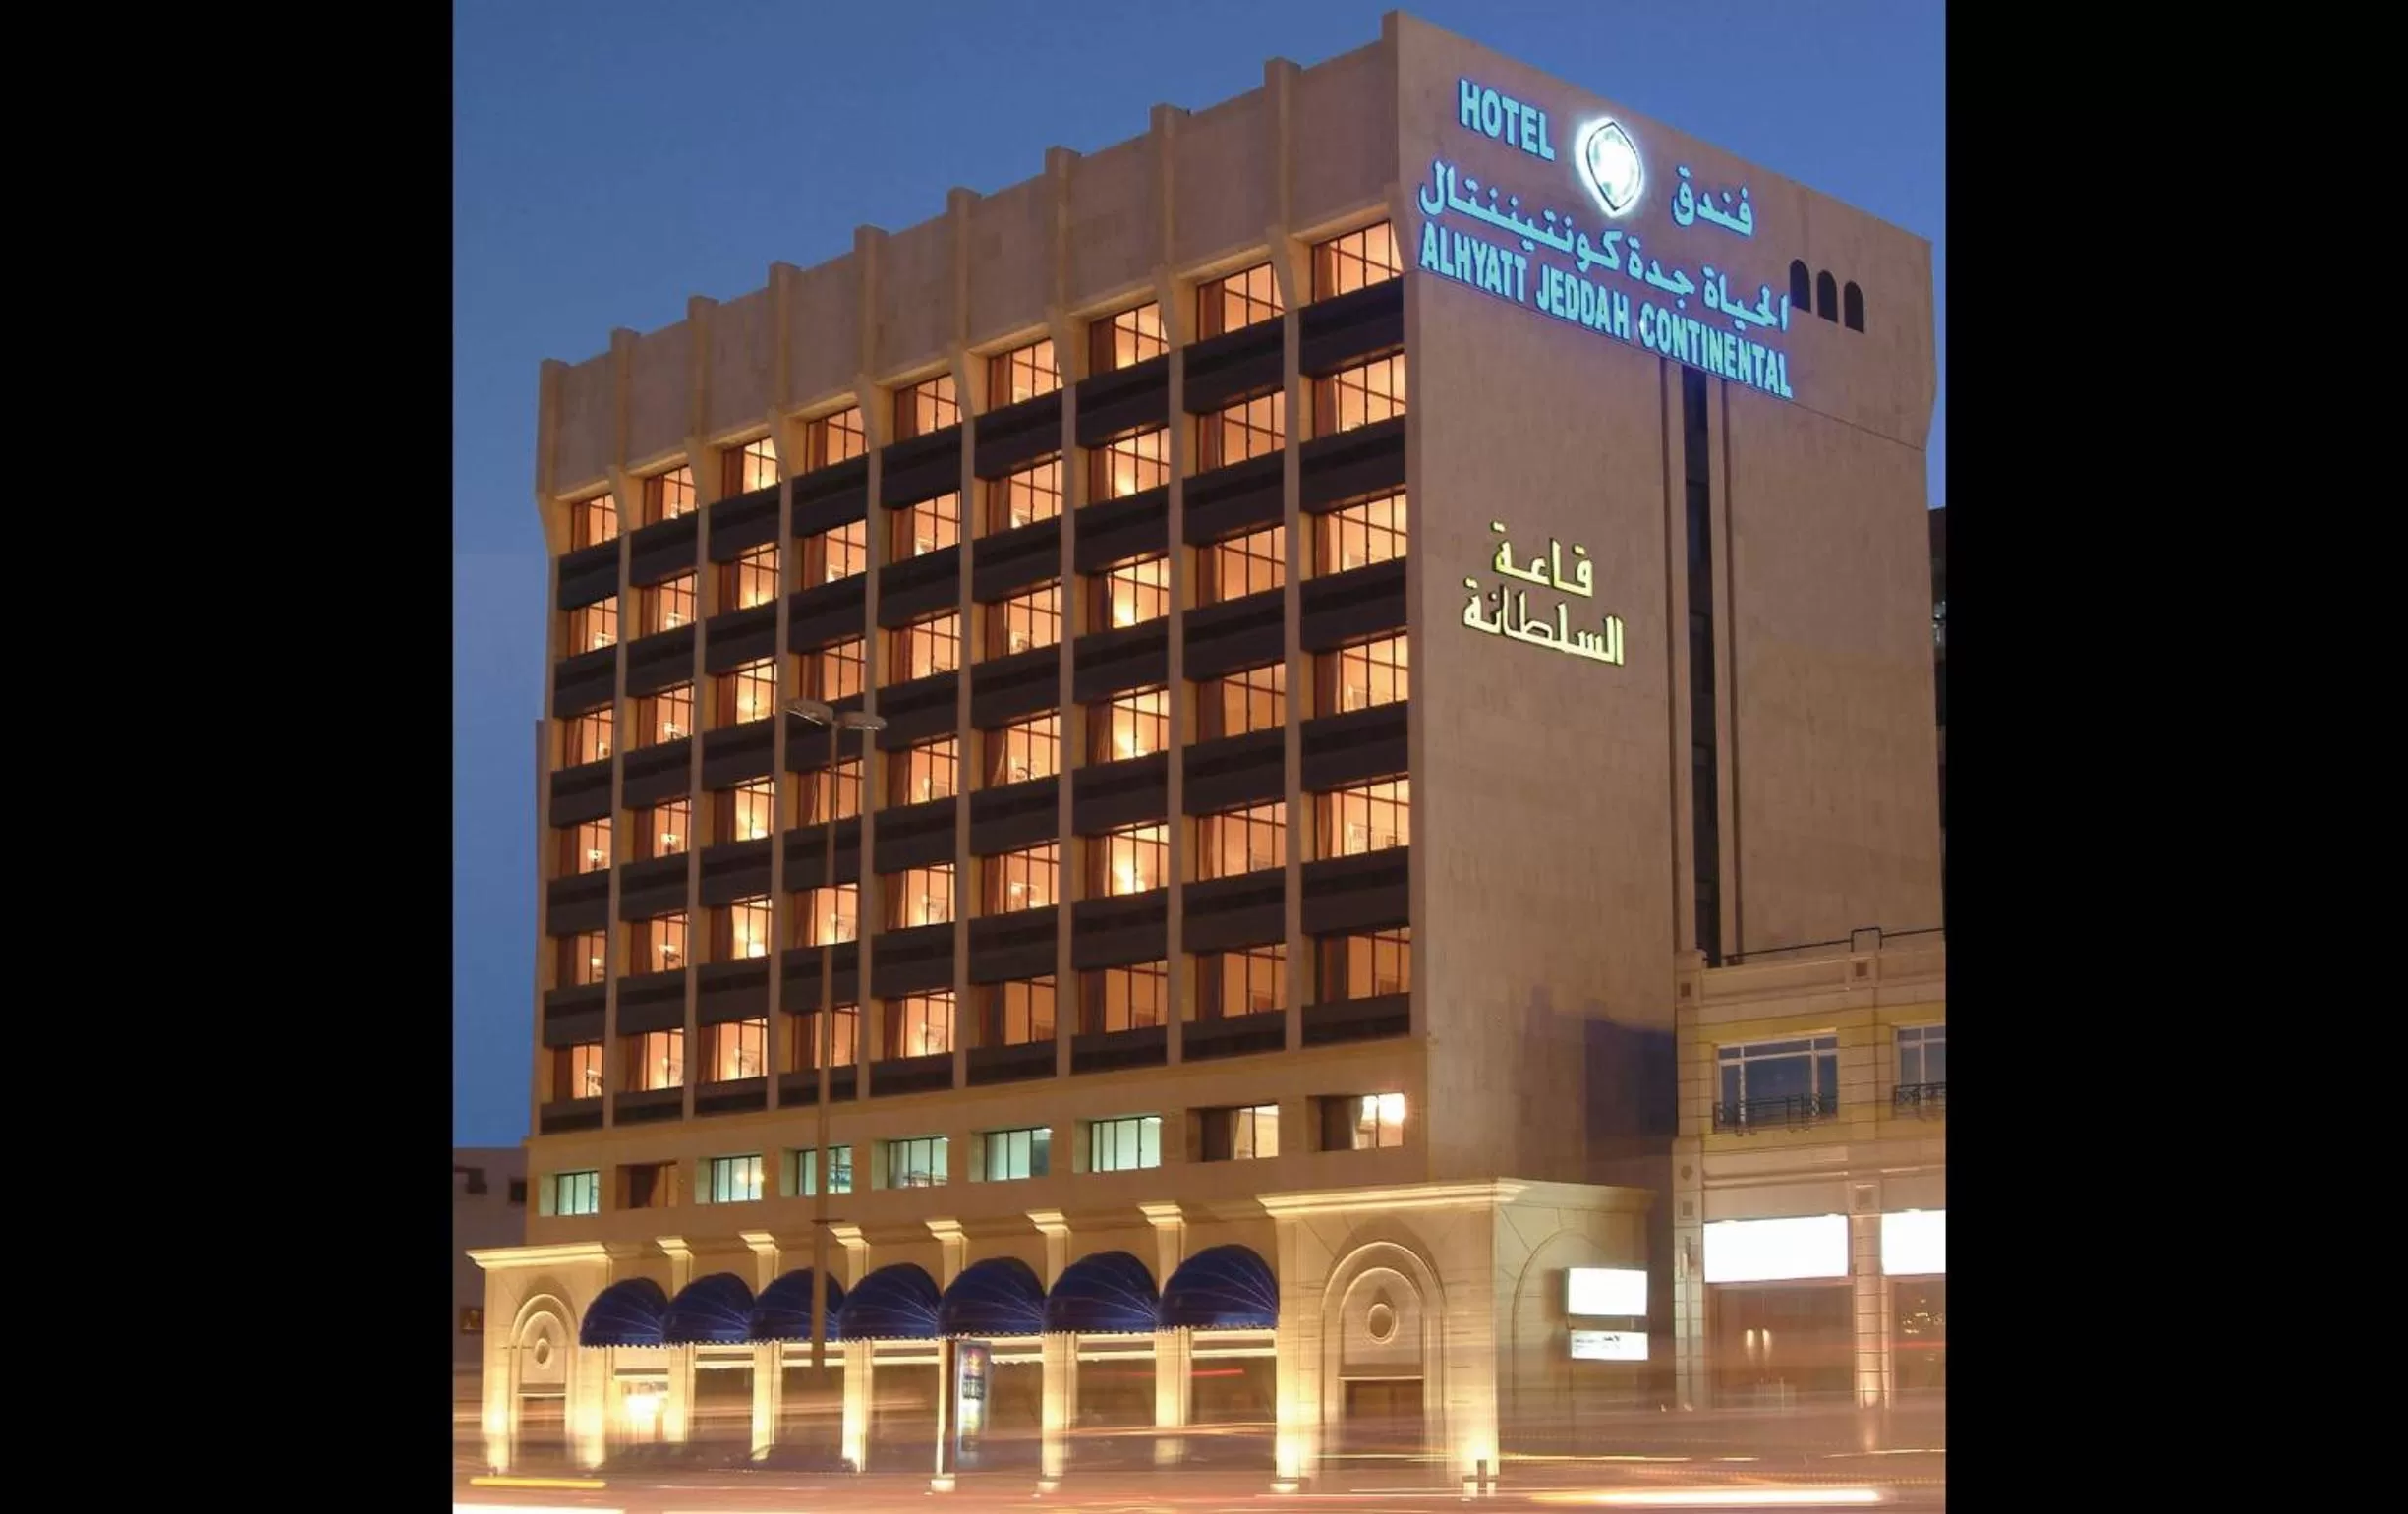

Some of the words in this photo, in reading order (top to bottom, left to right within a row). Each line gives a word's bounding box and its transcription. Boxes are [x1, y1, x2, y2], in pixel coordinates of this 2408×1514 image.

[1459, 78, 1555, 161] HOTEL
[1418, 160, 1623, 273] كونتيننتال
[1672, 164, 1753, 237] فندق
[1420, 220, 1527, 302] ALHYATT
[1536, 263, 1631, 341] JEDDAH
[1638, 301, 1793, 399] CONTINENTAL
[1627, 234, 1695, 310] جدة
[1702, 264, 1789, 331] الحياة
[1491, 520, 1593, 598] قاعة
[1462, 575, 1625, 667] السلطانة
